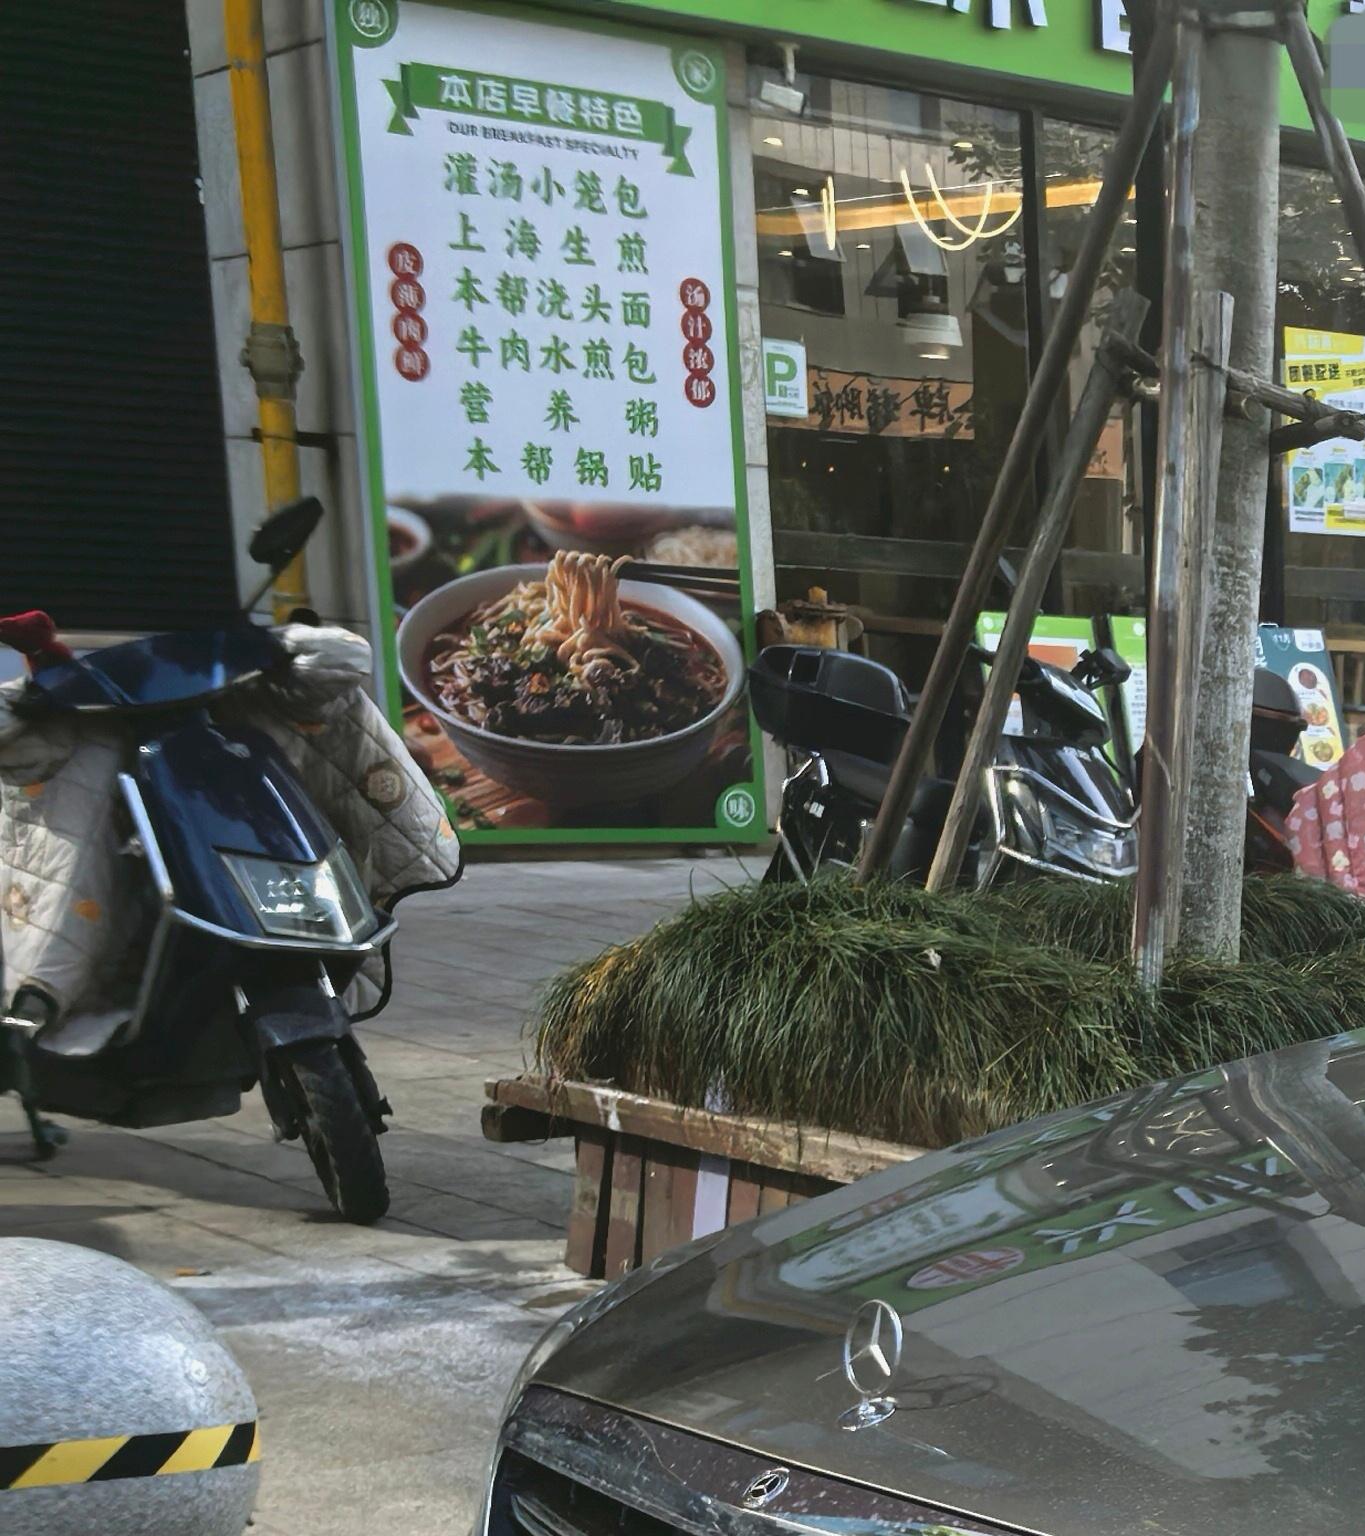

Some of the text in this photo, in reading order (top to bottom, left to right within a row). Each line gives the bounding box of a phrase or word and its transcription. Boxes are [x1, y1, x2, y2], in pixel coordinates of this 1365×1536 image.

[440, 75, 643, 135] 本店早餐特色
[449, 121, 478, 136] OUR
[444, 152, 647, 218] 灌汤小笼包
[449, 213, 650, 274] 上海生煎
[453, 267, 650, 329] 本帮浇头面
[456, 325, 657, 384] 牛肉水煎包
[460, 381, 659, 438] 营养粥
[463, 437, 664, 492] 本帮锅贴
